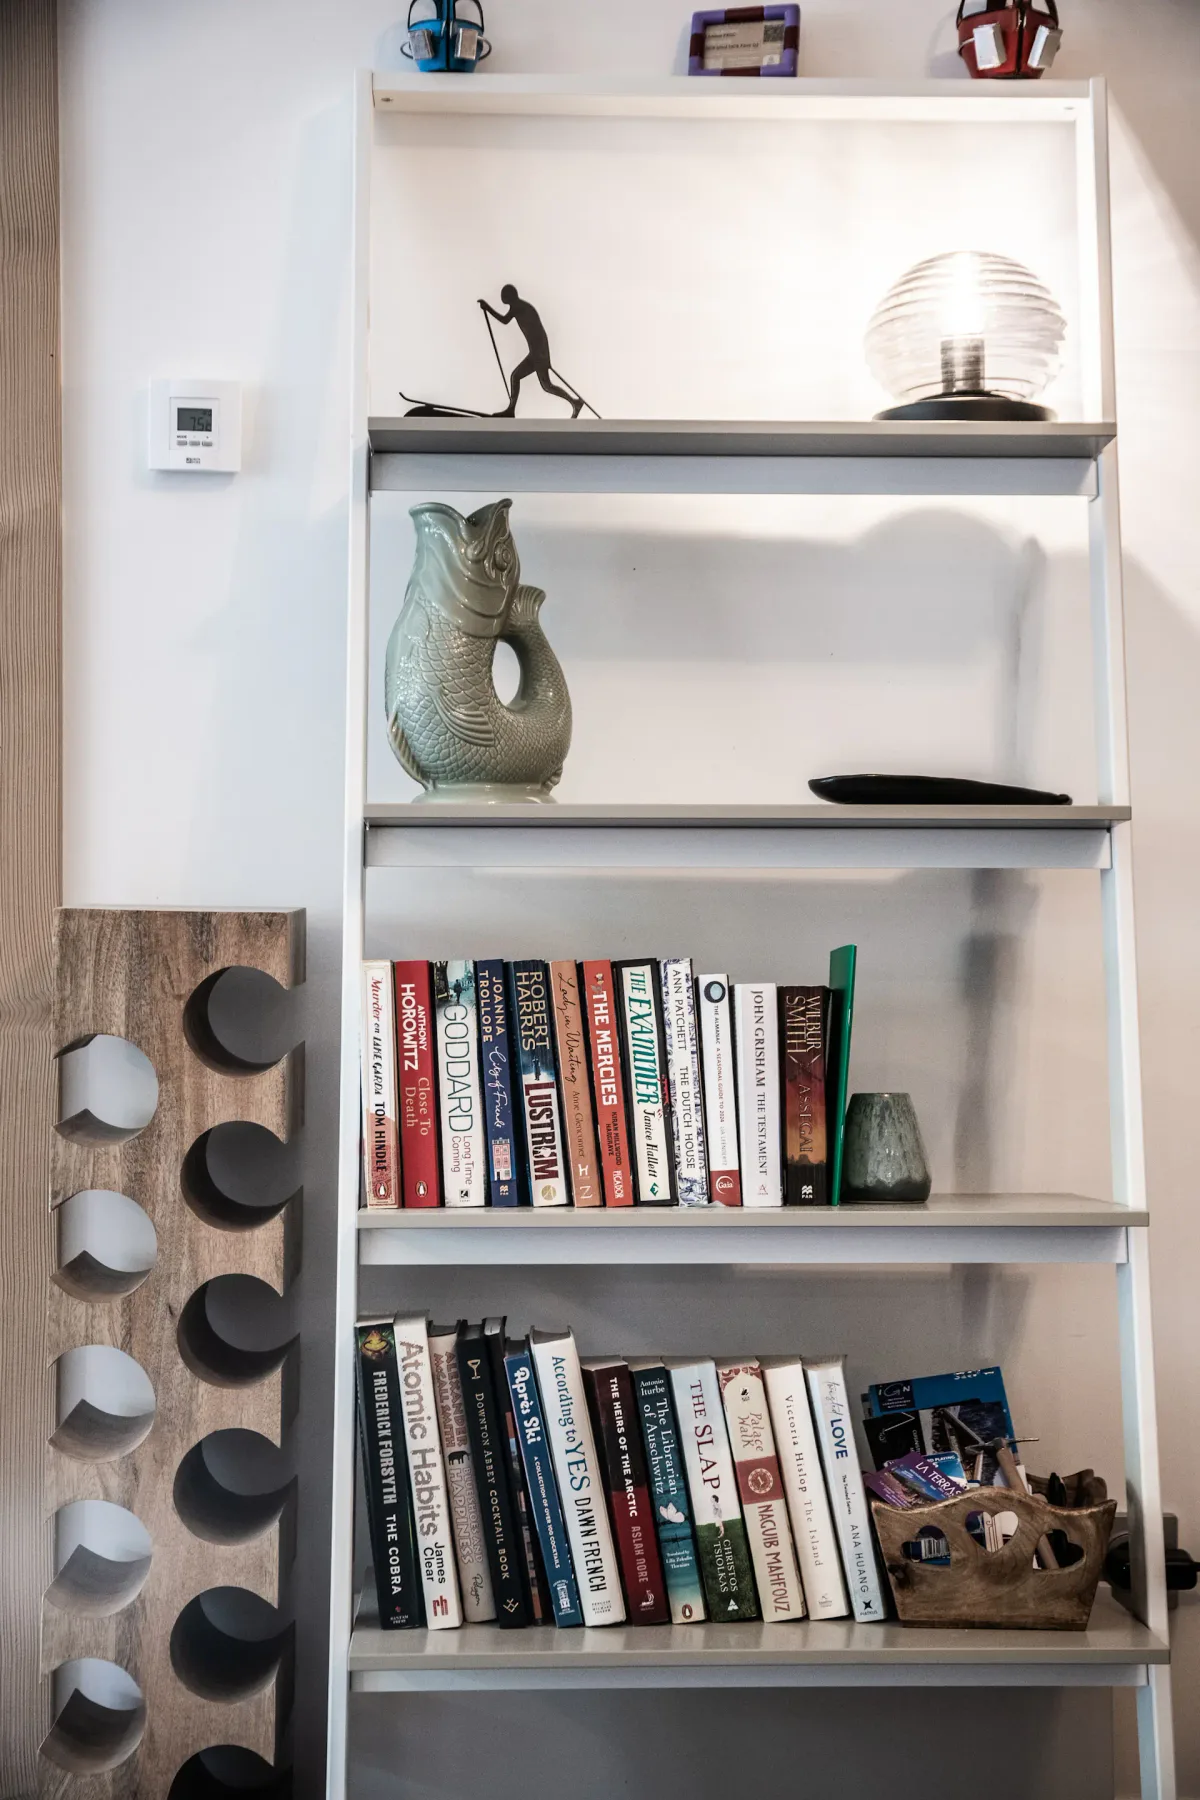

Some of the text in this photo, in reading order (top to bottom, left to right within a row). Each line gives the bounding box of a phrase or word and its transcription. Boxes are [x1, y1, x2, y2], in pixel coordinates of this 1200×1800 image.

[371, 977, 383, 1095] Murder on LAKE GARDA
[401, 984, 418, 1070] HOROWITZ
[418, 1005, 427, 1050] ANTHONY
[479, 970, 492, 1042] TROLLOPE
[493, 977, 505, 1036] JOANNA
[516, 972, 535, 1051] HARRIS
[530, 971, 549, 1049] ROBERT
[557, 972, 580, 1085] Lady in Waiting
[628, 972, 660, 1104] THE EXAMINER
[673, 970, 686, 1050] ANN PATCHETT
[751, 990, 765, 1087] JOHN GRISHAM
[786, 996, 806, 1053] SMITH
[806, 996, 821, 1052] WILBUR
[444, 1005, 473, 1132] GODDARD
[592, 991, 617, 1105] THE MERCIES
[405, 1087, 418, 1127] Death
[418, 1077, 431, 1135] Close To
[487, 1046, 507, 1128] City of Friends
[679, 1066, 695, 1169] THE DUTCH HOUSE
[799, 1085, 813, 1152] ASSEGAI
[375, 1102, 387, 1172] TOM HINDLE
[451, 1136, 462, 1173] Coming
[573, 1091, 586, 1157] Anne Glenconner
[606, 1123, 614, 1156] HARGRAVE
[611, 1111, 622, 1166] KIRAN MILLWOOD
[643, 1109, 658, 1178] Janice Hallett
[757, 1092, 767, 1176] THE TESTAMENT
[462, 1135, 473, 1185] Long Time
[613, 1170, 624, 1198] PICADOR
[718, 1181, 733, 1189] Gaia
[439, 1404, 455, 1448] SMITH
[444, 1352, 468, 1448] ALEXANDER
[511, 1367, 541, 1444] Après Ski
[551, 1356, 591, 1492] According to YES
[641, 1388, 665, 1396] Iturbe
[373, 1371, 396, 1504] FREDERICK FORSYTH
[399, 1340, 440, 1536] Atomic Habits
[609, 1378, 638, 1517] THE HEIRS OF THE ARCTIC
[643, 1405, 665, 1494] of Auschwitz
[655, 1398, 679, 1495] The Librarian
[690, 1380, 720, 1489] THE SLAP
[750, 1413, 764, 1452] Palace
[784, 1395, 808, 1493] Victoria Hislop
[830, 1419, 848, 1459] LOVE
[475, 1393, 510, 1579] DOWNTON ABBEY COCKTAIL BOOK
[535, 1461, 548, 1498] COLLECTION
[915, 1462, 929, 1474] LA
[449, 1468, 473, 1564] HAPPINESS
[462, 1467, 483, 1563] BLUE SHOES AND
[543, 1499, 550, 1507] OF
[544, 1508, 552, 1524] OVER
[574, 1498, 597, 1537] DAWN
[803, 1500, 823, 1567] The Island
[386, 1514, 401, 1594] THE COBRA
[423, 1547, 435, 1582] Clear
[433, 1542, 447, 1584] James
[550, 1536, 561, 1568] COCKTAILS
[582, 1542, 607, 1592] FRENCH
[631, 1526, 648, 1582] ASLAK NORE
[713, 1541, 728, 1592] TSIOLKAS
[723, 1539, 738, 1591] CHRISTOS
[758, 1504, 790, 1613] NAGUIB MAHFOUZ
[850, 1524, 868, 1593] ANA HUANG
[470, 1574, 483, 1606] Polygon
